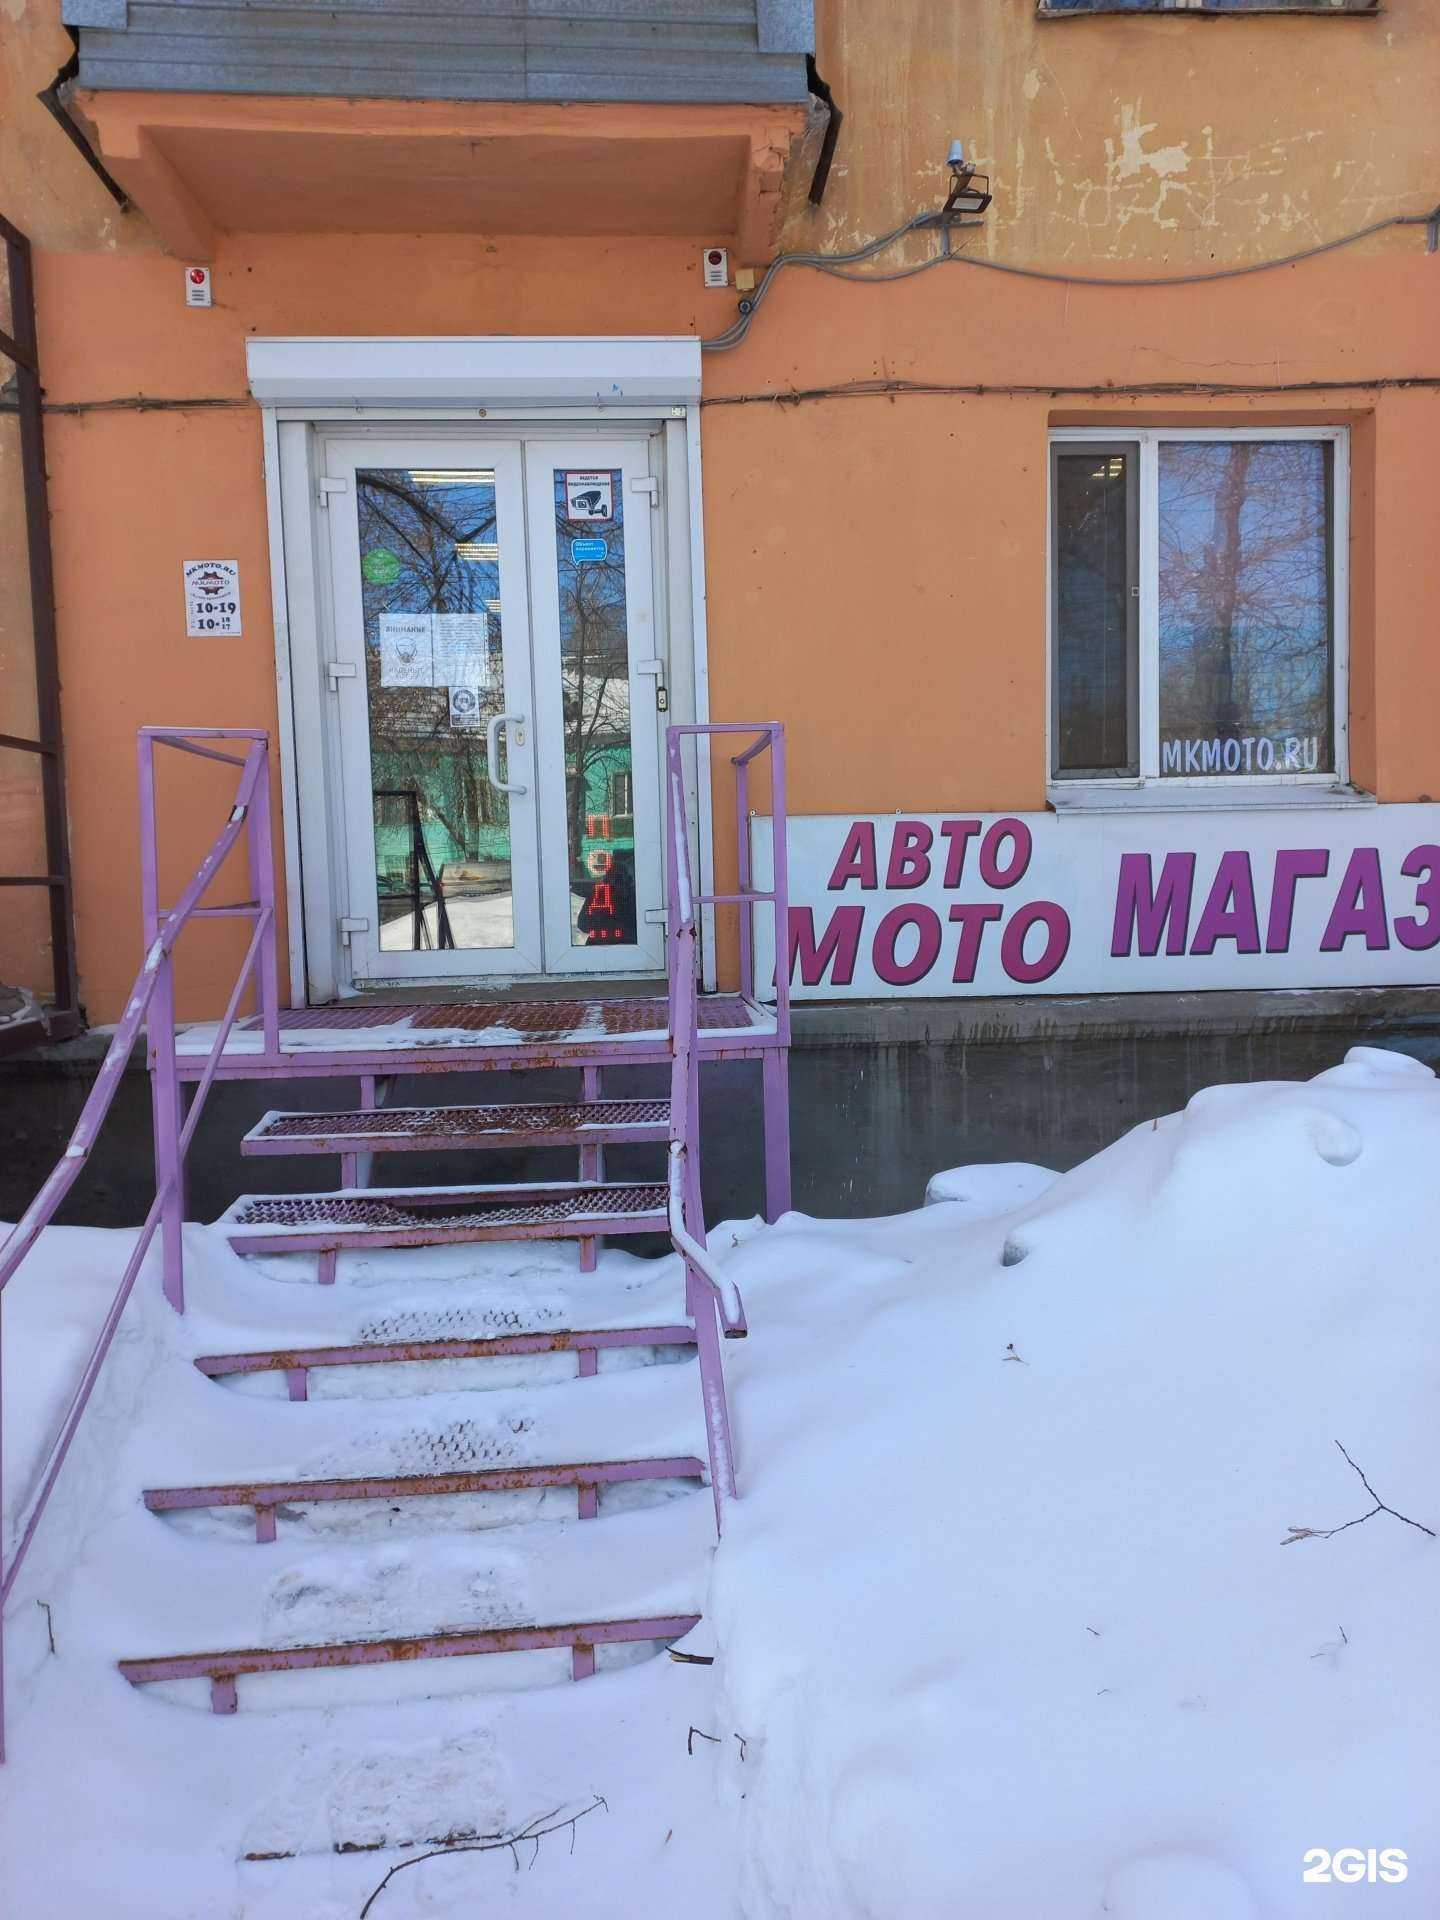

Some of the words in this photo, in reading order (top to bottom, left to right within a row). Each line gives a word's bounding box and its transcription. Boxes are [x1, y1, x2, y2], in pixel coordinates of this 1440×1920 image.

[195, 602, 237, 614] 10-19
[1162, 736, 1318, 774] MKMOTO.RU
[826, 817, 1033, 891] АВТО
[1110, 844, 1440, 957] МАГАЗ
[772, 899, 1072, 987] МОТО
